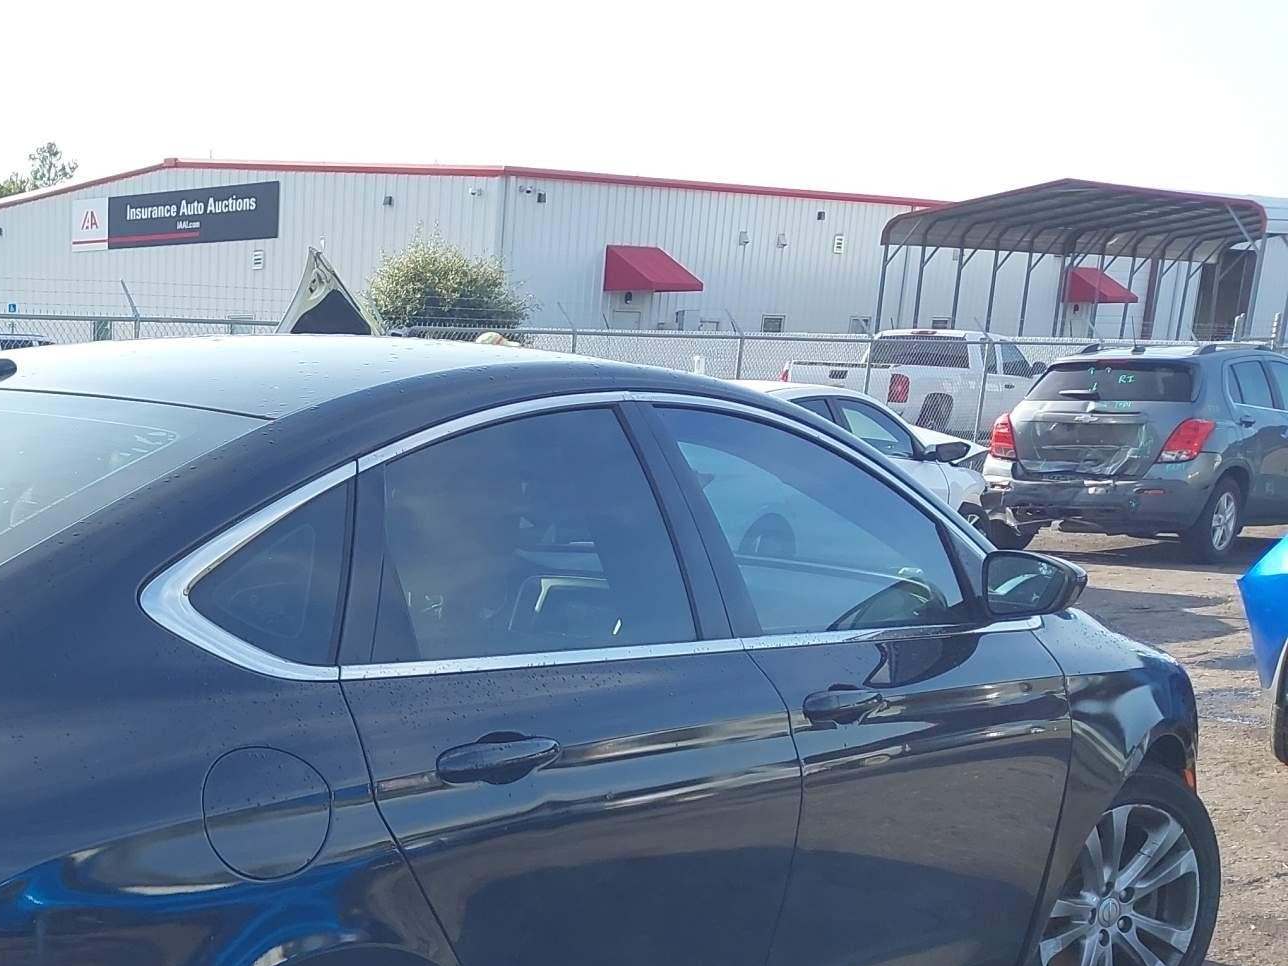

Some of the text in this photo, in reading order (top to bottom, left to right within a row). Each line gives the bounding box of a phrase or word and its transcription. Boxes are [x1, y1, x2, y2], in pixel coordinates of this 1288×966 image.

[126, 195, 256, 221] Insurance Auto Auctions
